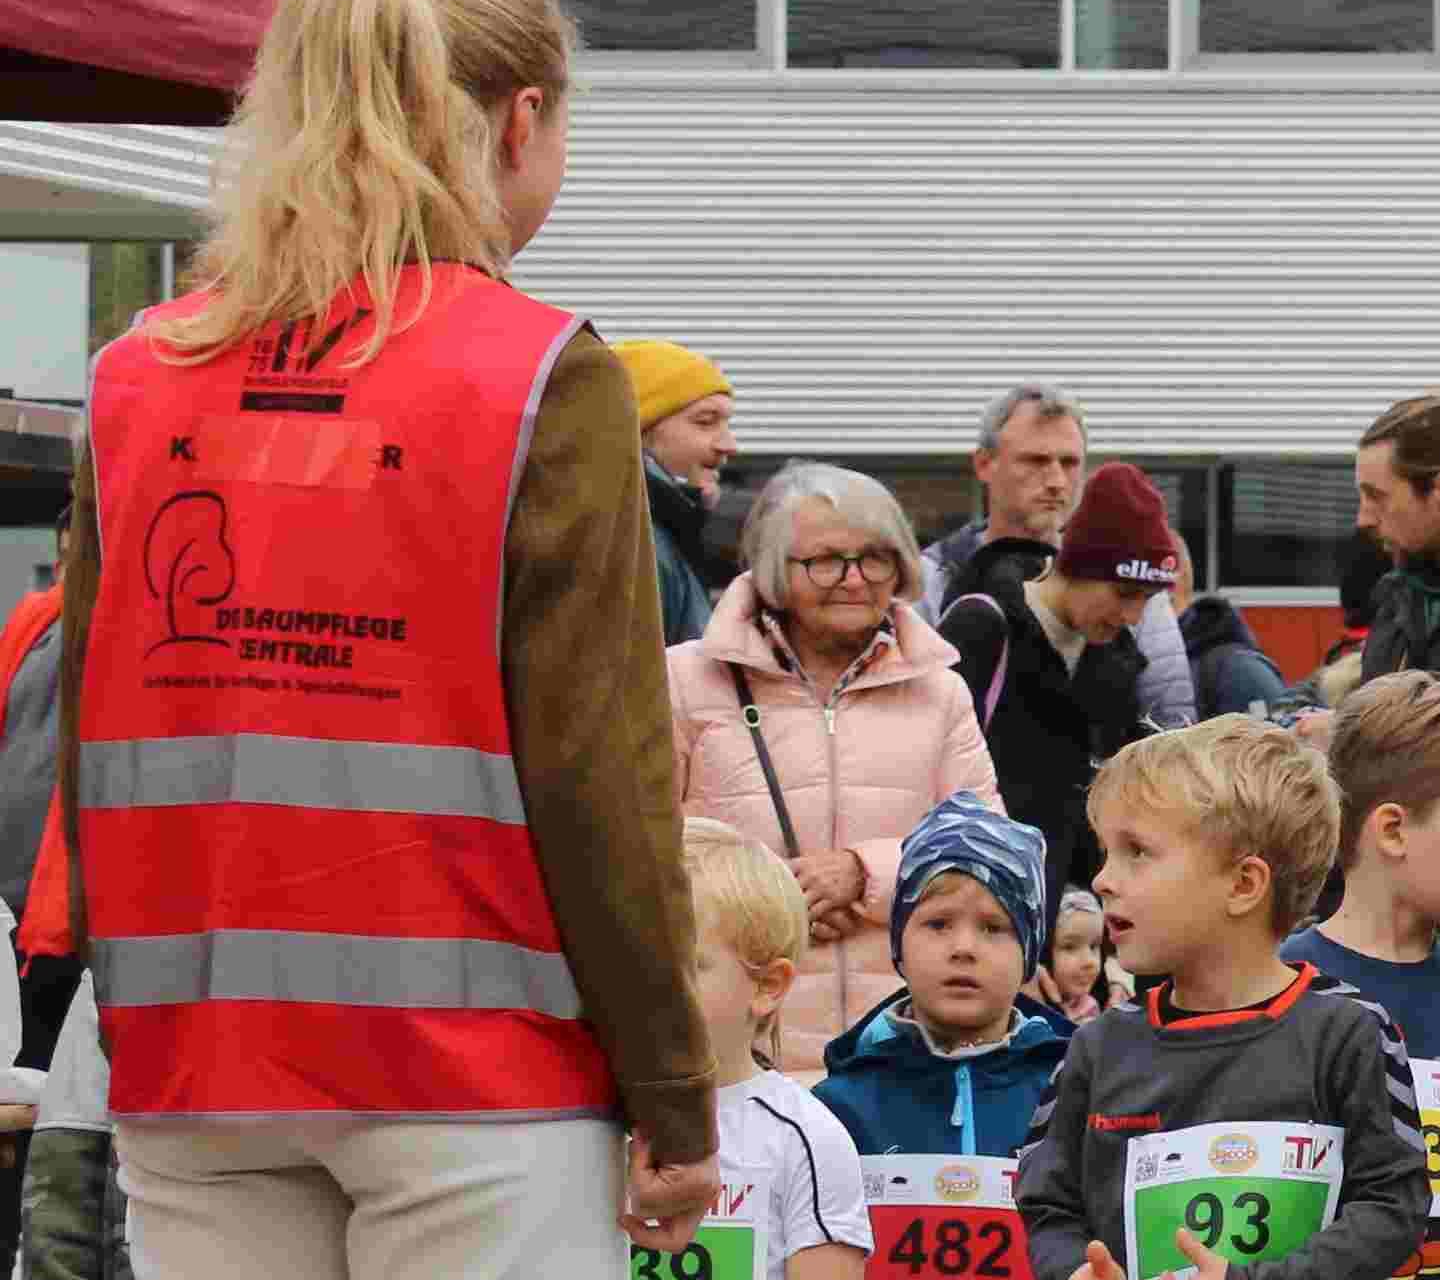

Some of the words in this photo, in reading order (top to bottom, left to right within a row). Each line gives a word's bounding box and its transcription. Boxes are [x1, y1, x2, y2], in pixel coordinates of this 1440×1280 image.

[1285, 1135, 1335, 1170] TV
[887, 1217, 1013, 1277] 482
[1184, 1192, 1272, 1255] 93
